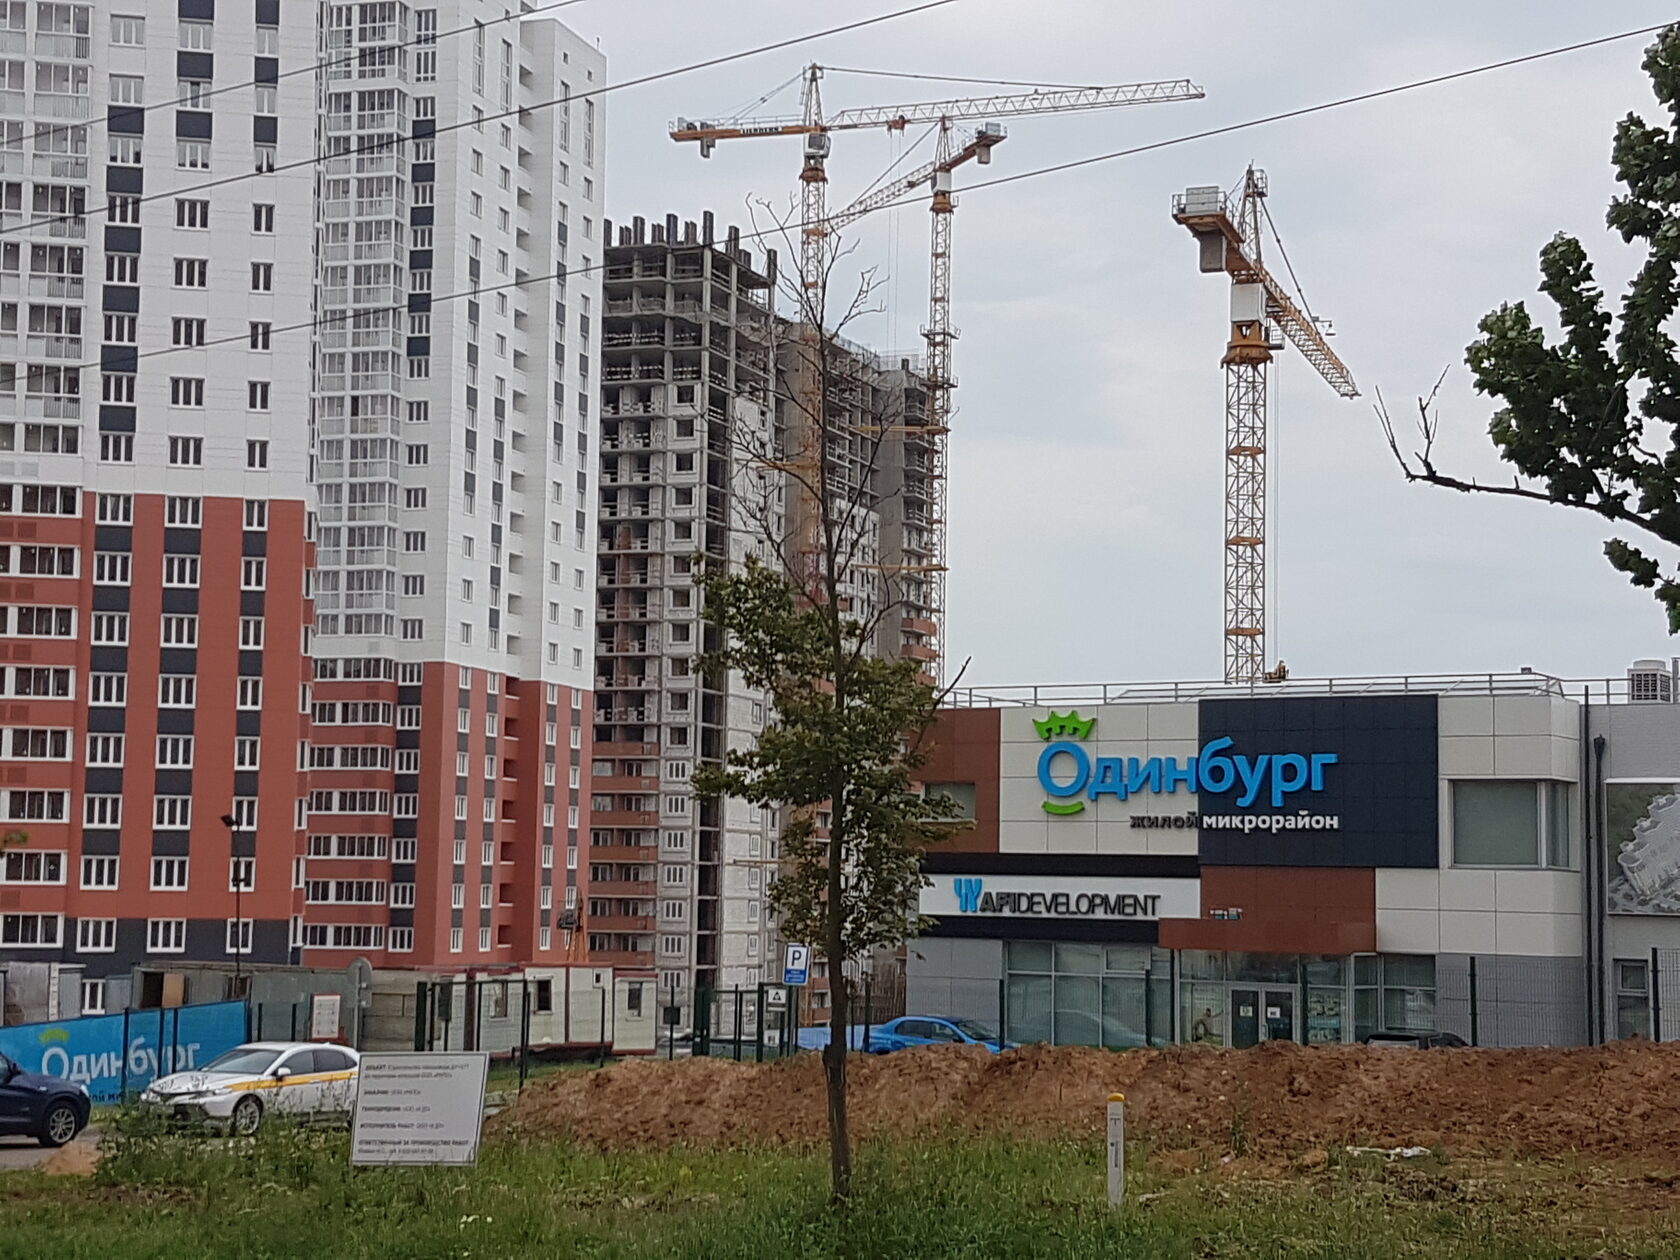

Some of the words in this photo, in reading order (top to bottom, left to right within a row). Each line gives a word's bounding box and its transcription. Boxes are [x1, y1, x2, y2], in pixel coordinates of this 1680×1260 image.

[1037, 736, 1339, 808] Одинбург
[1130, 811, 1198, 829] жилой
[1202, 810, 1339, 834] микрорайон
